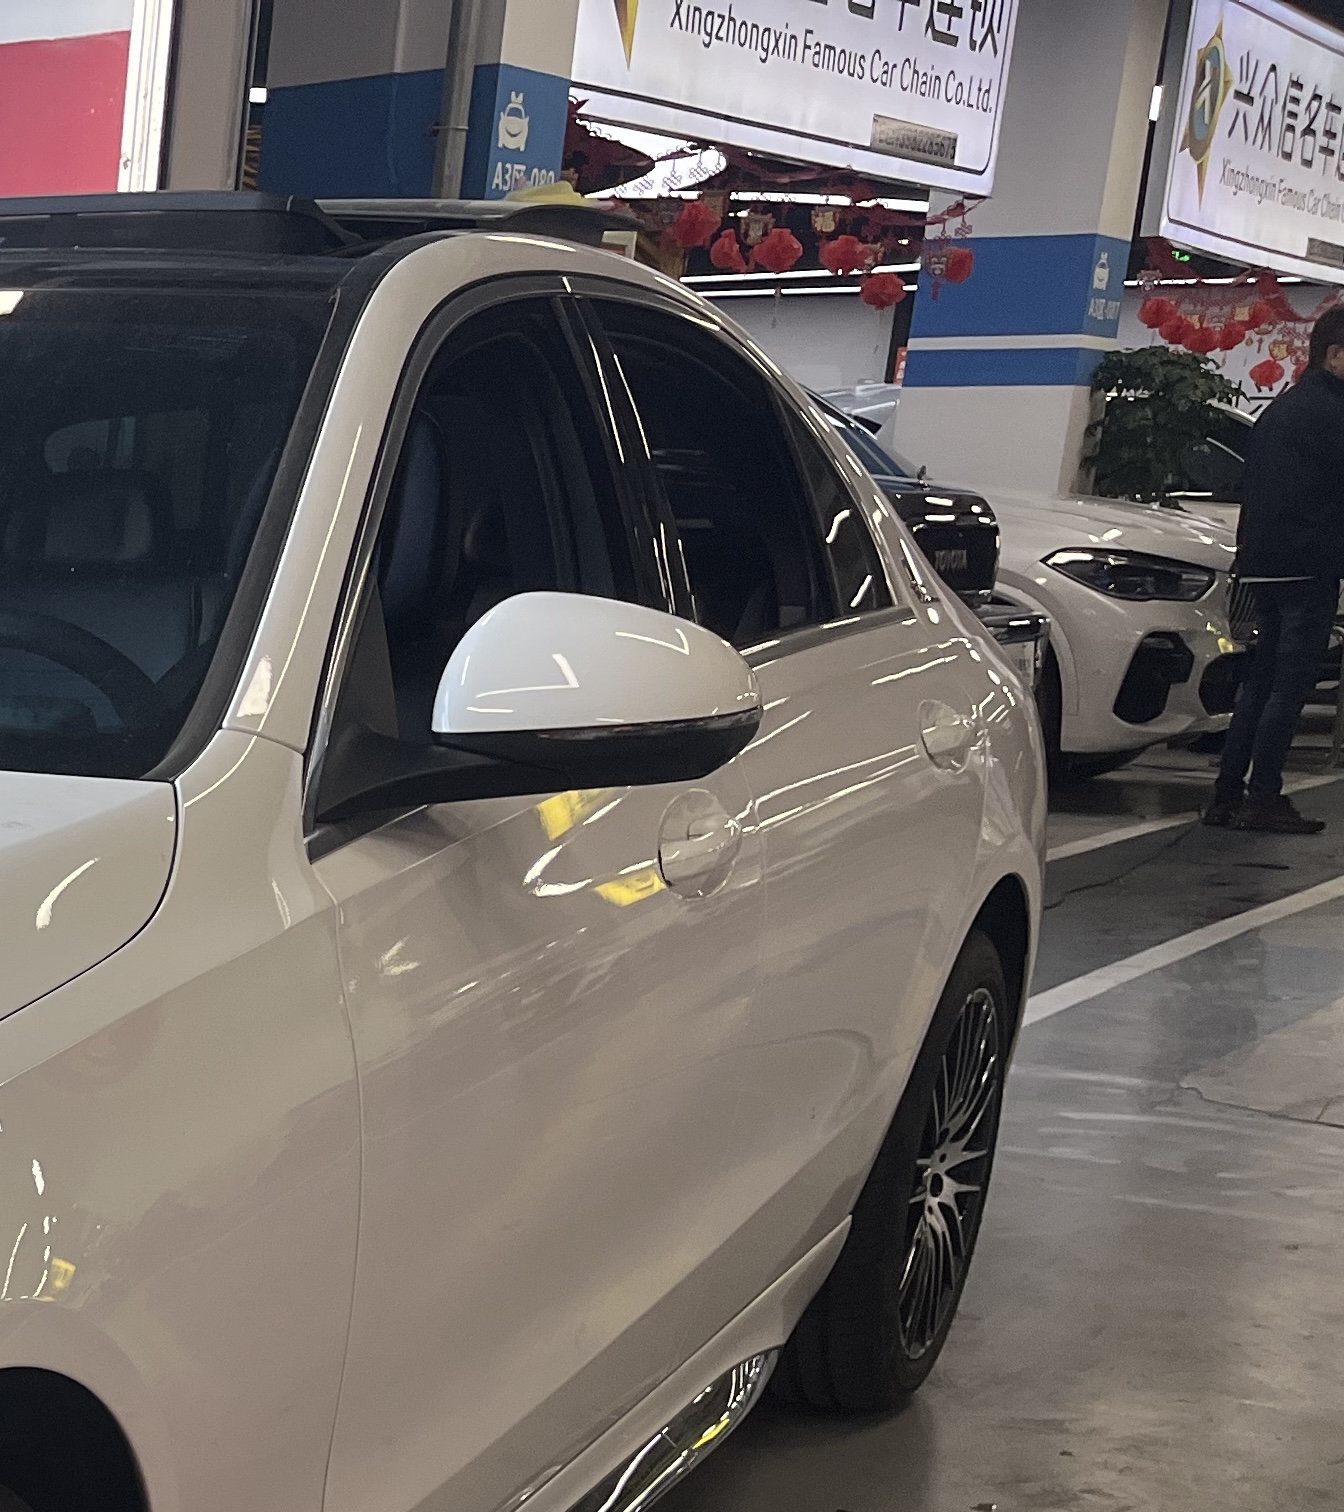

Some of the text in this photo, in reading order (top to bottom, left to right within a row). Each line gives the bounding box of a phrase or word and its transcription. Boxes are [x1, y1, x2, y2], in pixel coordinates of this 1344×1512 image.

[670, 0, 798, 63] Xingzhongxin
[801, 28, 866, 80] Famous
[870, 49, 897, 88] Car
[900, 57, 942, 100] Chain
